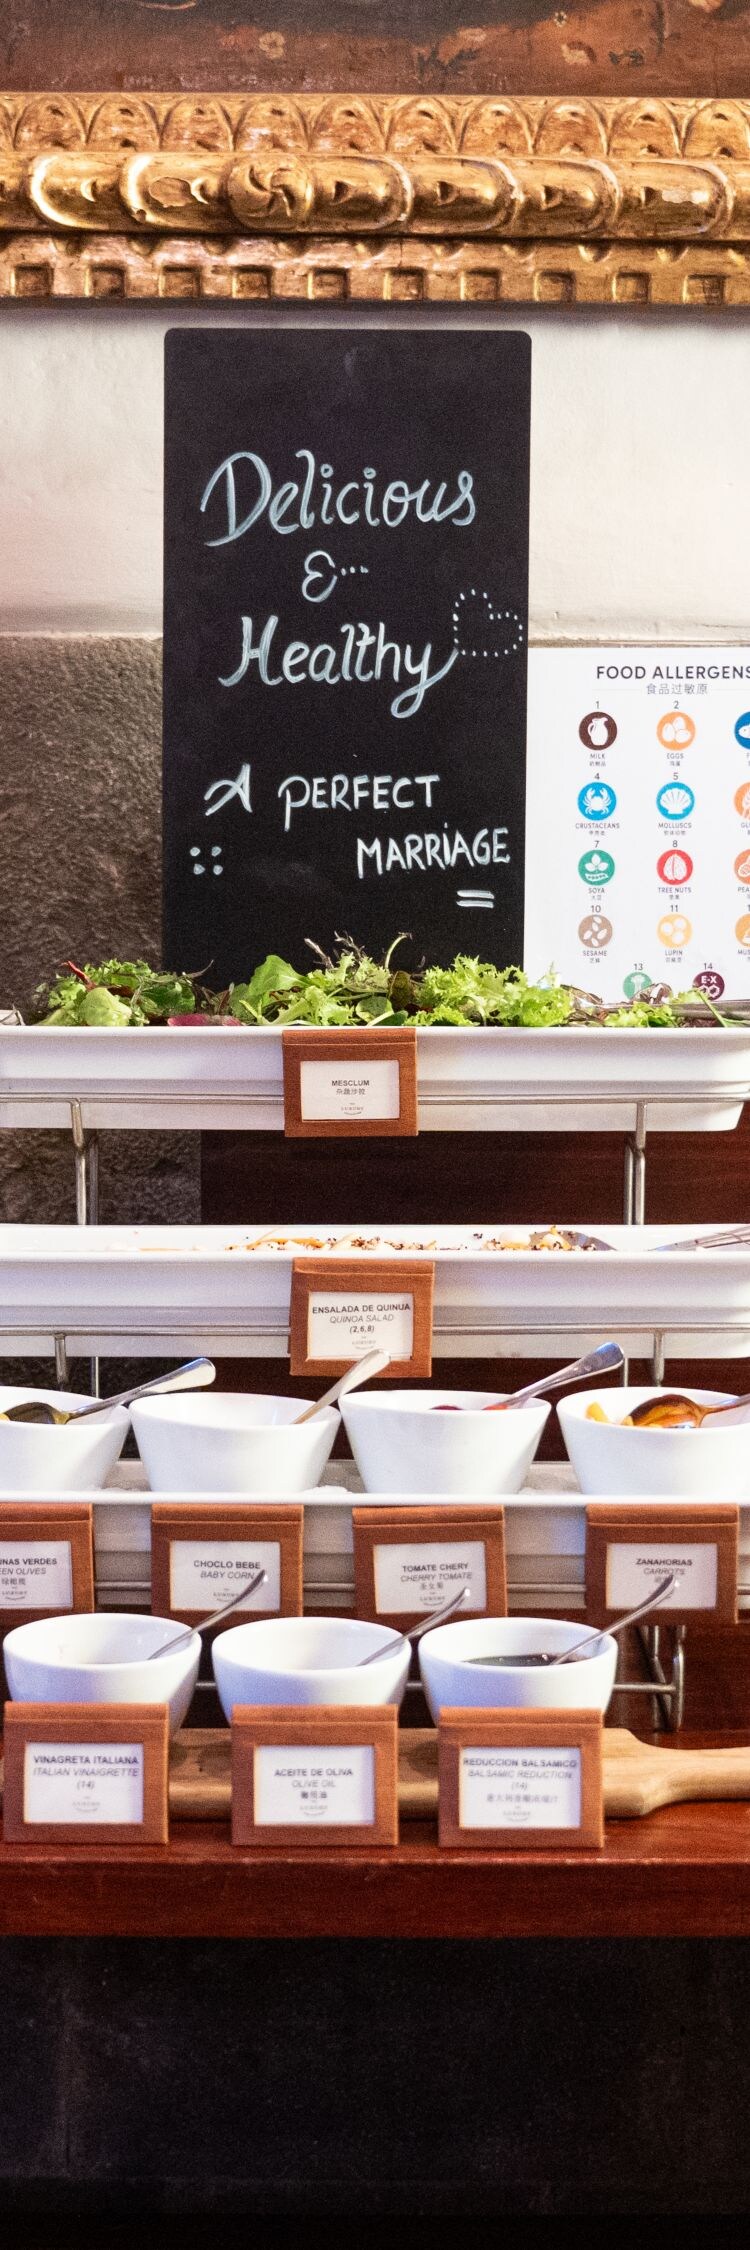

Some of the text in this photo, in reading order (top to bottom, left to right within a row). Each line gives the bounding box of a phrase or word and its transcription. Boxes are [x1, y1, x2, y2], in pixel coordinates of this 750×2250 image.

[200, 449, 478, 547] Delicious
[218, 614, 458, 719] Healthy
[596, 665, 646, 680] FOOD
[646, 683, 708, 696] 食品过敏原
[673, 701, 679, 710] 2
[594, 772, 600, 780] 4
[673, 772, 679, 780] 5
[204, 763, 253, 816] A
[594, 840, 600, 848] 7
[672, 840, 678, 848] 8
[658, 886, 692, 894] TREE NUTS
[591, 905, 602, 913] 10
[670, 904, 679, 912] 11
[633, 963, 643, 971] 13
[312, 1303, 411, 1314] ENSALADA DE QUINUA
[329, 1313, 394, 1324] QUINOA SALAD
[22, 1557, 58, 1565] VERDES
[193, 1560, 261, 1570] CHOCLO BEBE
[635, 1558, 693, 1567] ZANAHORIAS
[16, 1567, 47, 1575] OLIVES
[402, 1562, 469, 1573] TOMATE CHERY
[643, 1567, 685, 1576] CARROTS
[200, 1571, 255, 1580] BABY CORN
[400, 1573, 436, 1583] CHERRY
[33, 1755, 139, 1765] VINAGRETA ITALIANA
[463, 1758, 578, 1768] REDUCCION BALSAMICO
[33, 1767, 140, 1777] ITALIAN VINAIGRETTE
[274, 1768, 353, 1777] ACEITE DE OLIVA
[468, 1769, 573, 1779] BALSAMIC REDUCTION
[291, 1779, 336, 1788] OLIVE OIL
